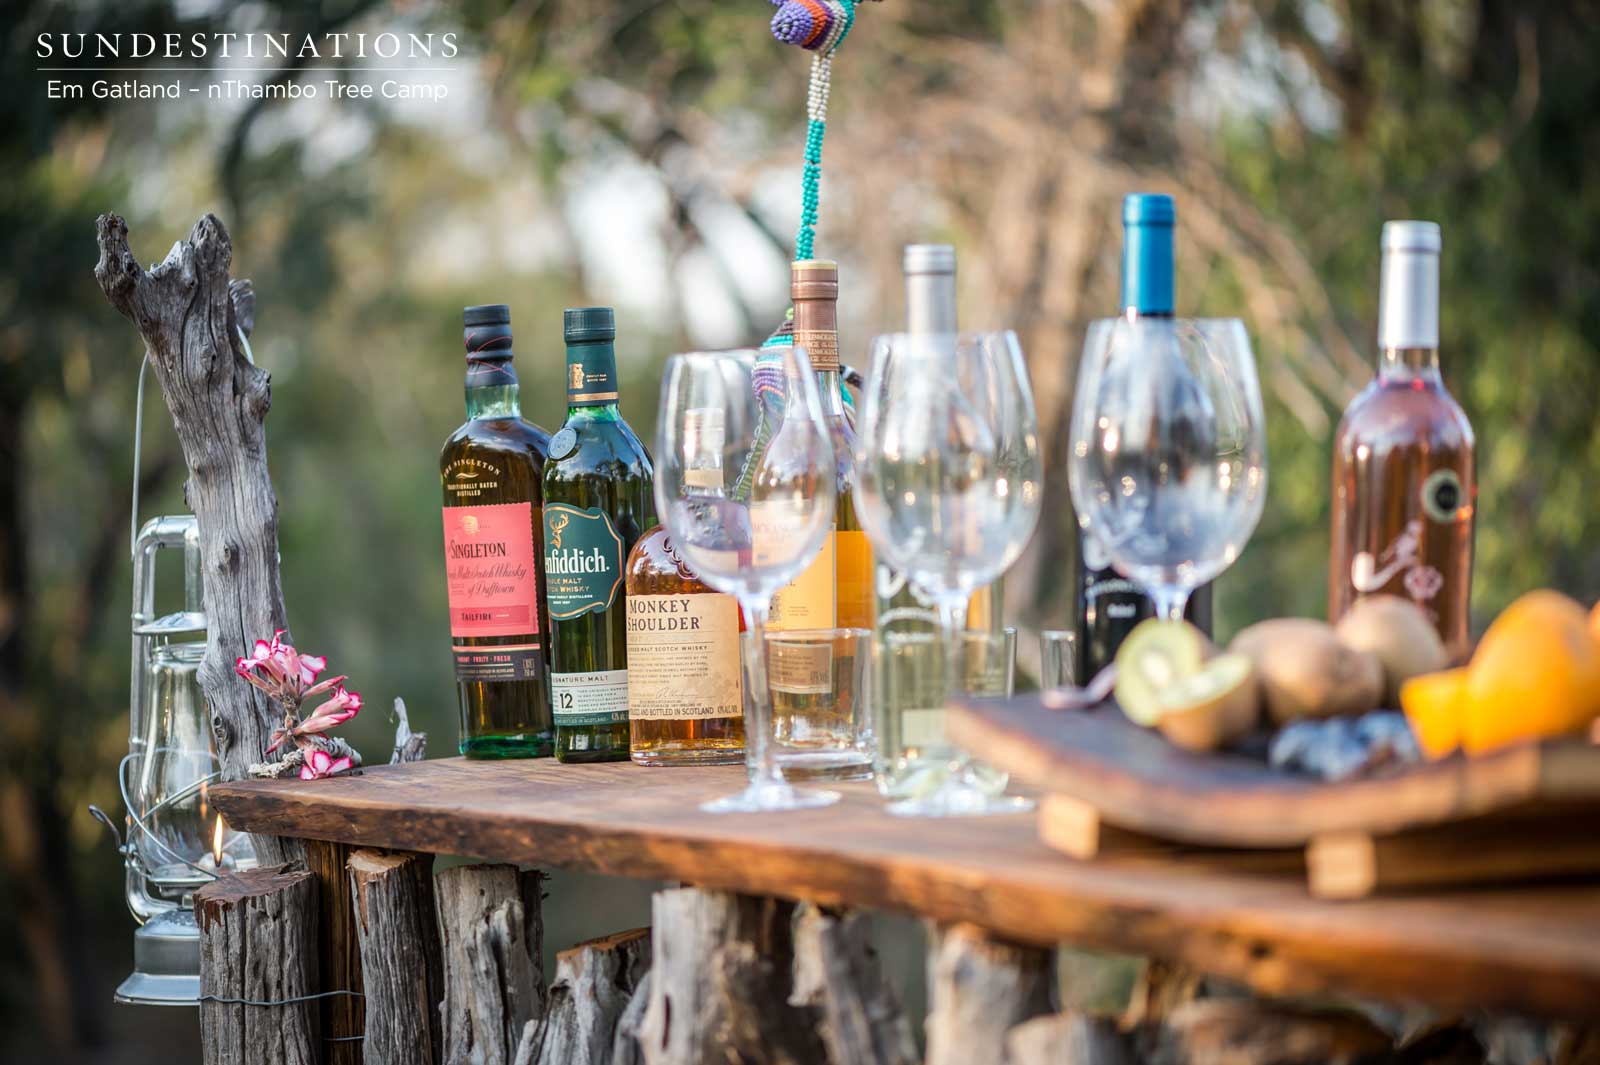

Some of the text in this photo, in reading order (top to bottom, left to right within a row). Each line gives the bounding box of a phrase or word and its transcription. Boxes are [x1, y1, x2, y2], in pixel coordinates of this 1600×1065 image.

[454, 458, 500, 476] SINGLETON
[450, 540, 506, 559] SINGLETON
[495, 563, 527, 580] Whisky
[630, 599, 690, 613] MONKEY
[628, 617, 700, 631] SHOULDER
[560, 693, 573, 709] 12
[682, 707, 714, 716] SCOTLAND
